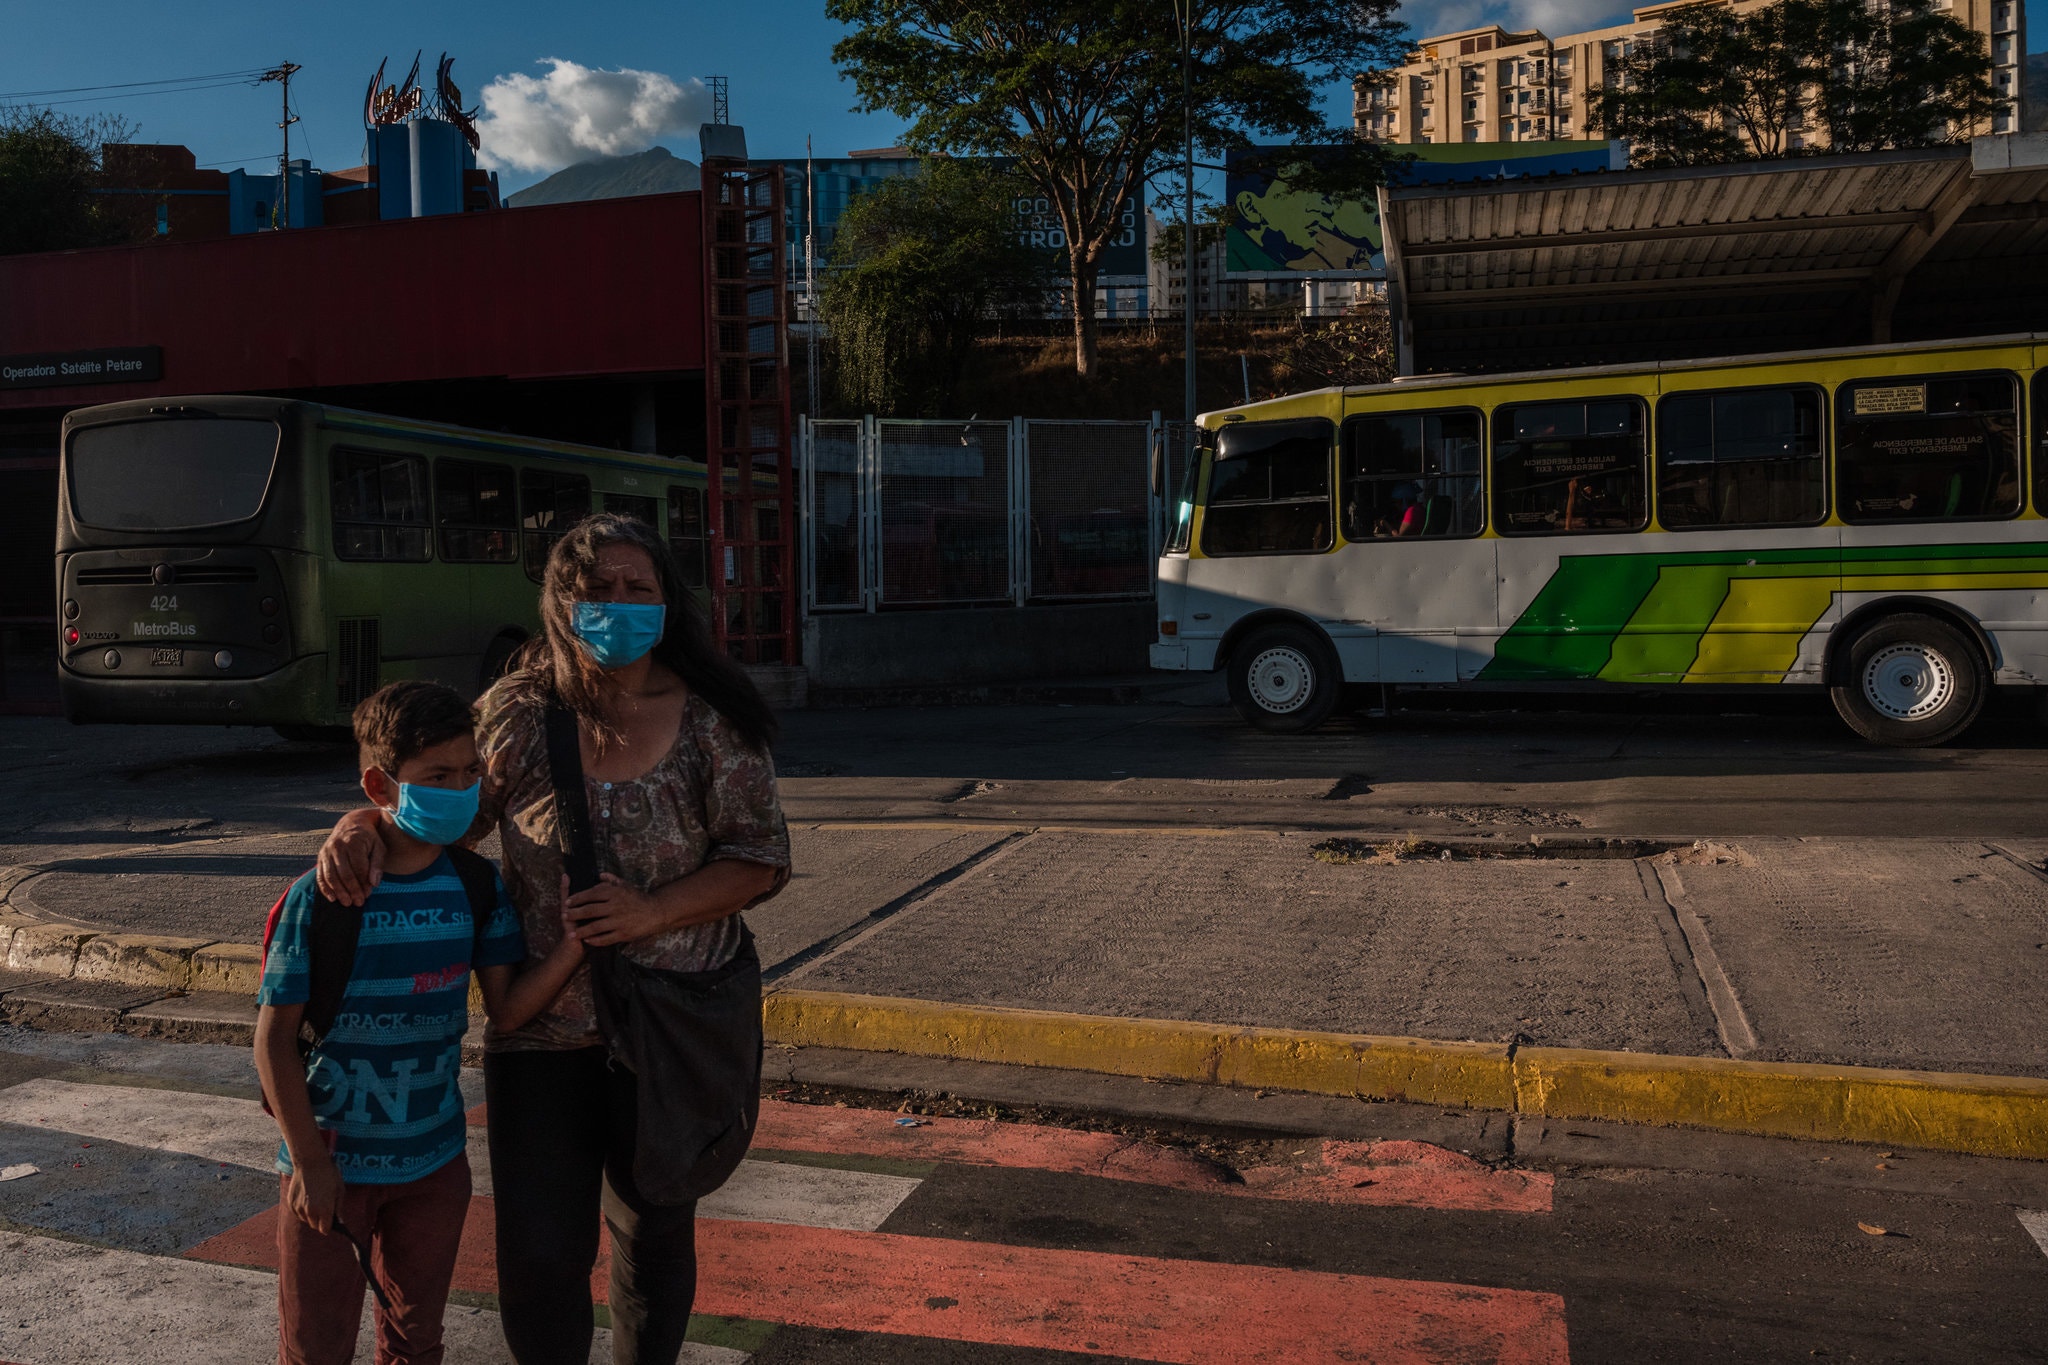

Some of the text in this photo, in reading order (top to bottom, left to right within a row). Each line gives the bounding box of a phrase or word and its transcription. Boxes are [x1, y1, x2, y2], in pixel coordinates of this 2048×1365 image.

[2, 364, 56, 381] Operadora
[106, 359, 143, 372] Petare
[150, 595, 178, 611] 424
[133, 622, 197, 636] MetroBus
[413, 1013, 449, 1026] Since
